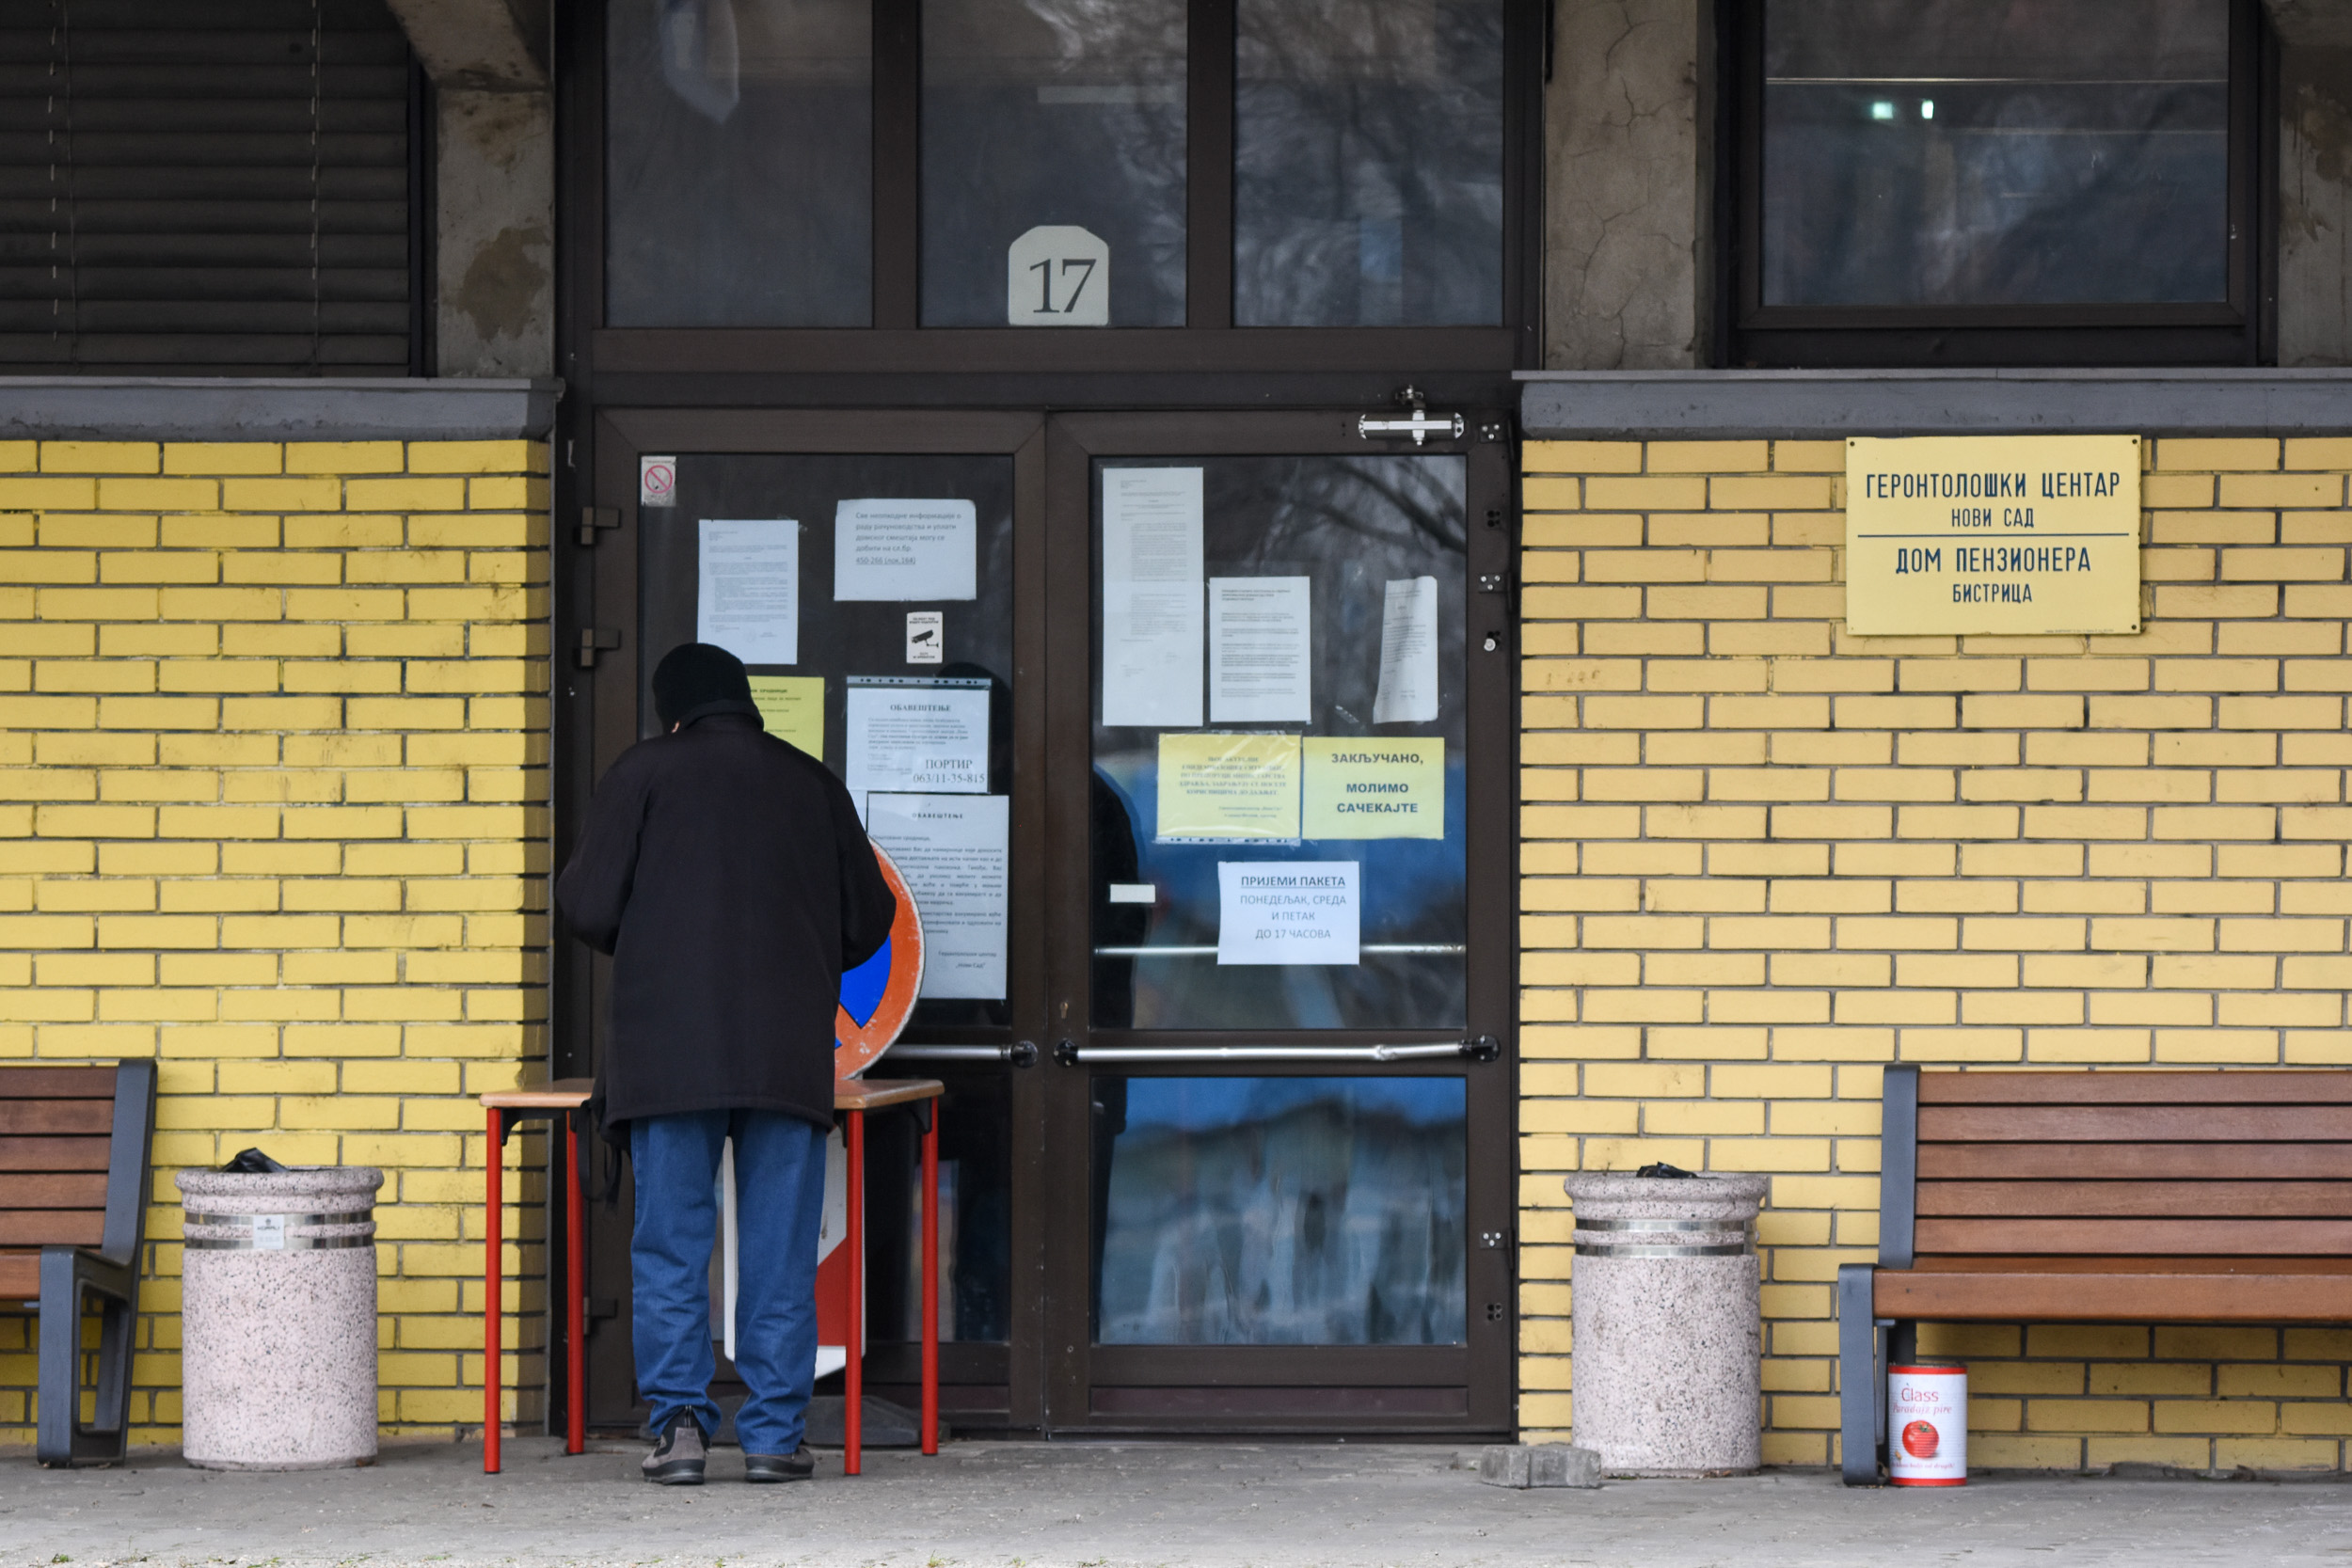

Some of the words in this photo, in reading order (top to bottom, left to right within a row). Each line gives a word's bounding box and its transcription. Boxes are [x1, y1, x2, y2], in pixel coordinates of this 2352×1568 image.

[1029, 258, 1097, 313] 17
[1867, 473, 2026, 499] ГЕРОНТОЛОШКИ
[2042, 471, 2121, 499] ЦЕНТАР
[1951, 508, 1992, 528] НОВИ
[2004, 508, 2035, 529] САД
[1896, 547, 1941, 574] ДОМ
[1956, 546, 2091, 572] ПЕНЗИОНЕРА
[1952, 583, 2033, 604] БИСТРИЦА
[926, 759, 973, 769] ПОРТИР
[1331, 753, 1423, 766] ЗАКЉУЧАНО,
[913, 773, 986, 784] 063/11-35-815
[1346, 784, 1409, 793] МОЛИМО
[1337, 803, 1419, 813] САЧЕКАЈТЕ
[1241, 876, 1296, 887] ПРИЈЕМИ
[1300, 876, 1345, 887] ПАКЕТА
[1240, 895, 1311, 906] ПОНЕДЕЉАК,
[1312, 895, 1347, 906] СРЕДА
[1271, 911, 1279, 921] И
[1282, 911, 1315, 921] ПЕТАК
[1255, 929, 1272, 940] ДО
[1275, 929, 1286, 939] 17
[1289, 929, 1331, 939] ЧАСОВА
[1901, 1387, 1939, 1402] Class
[1932, 1403, 1953, 1416] pire
